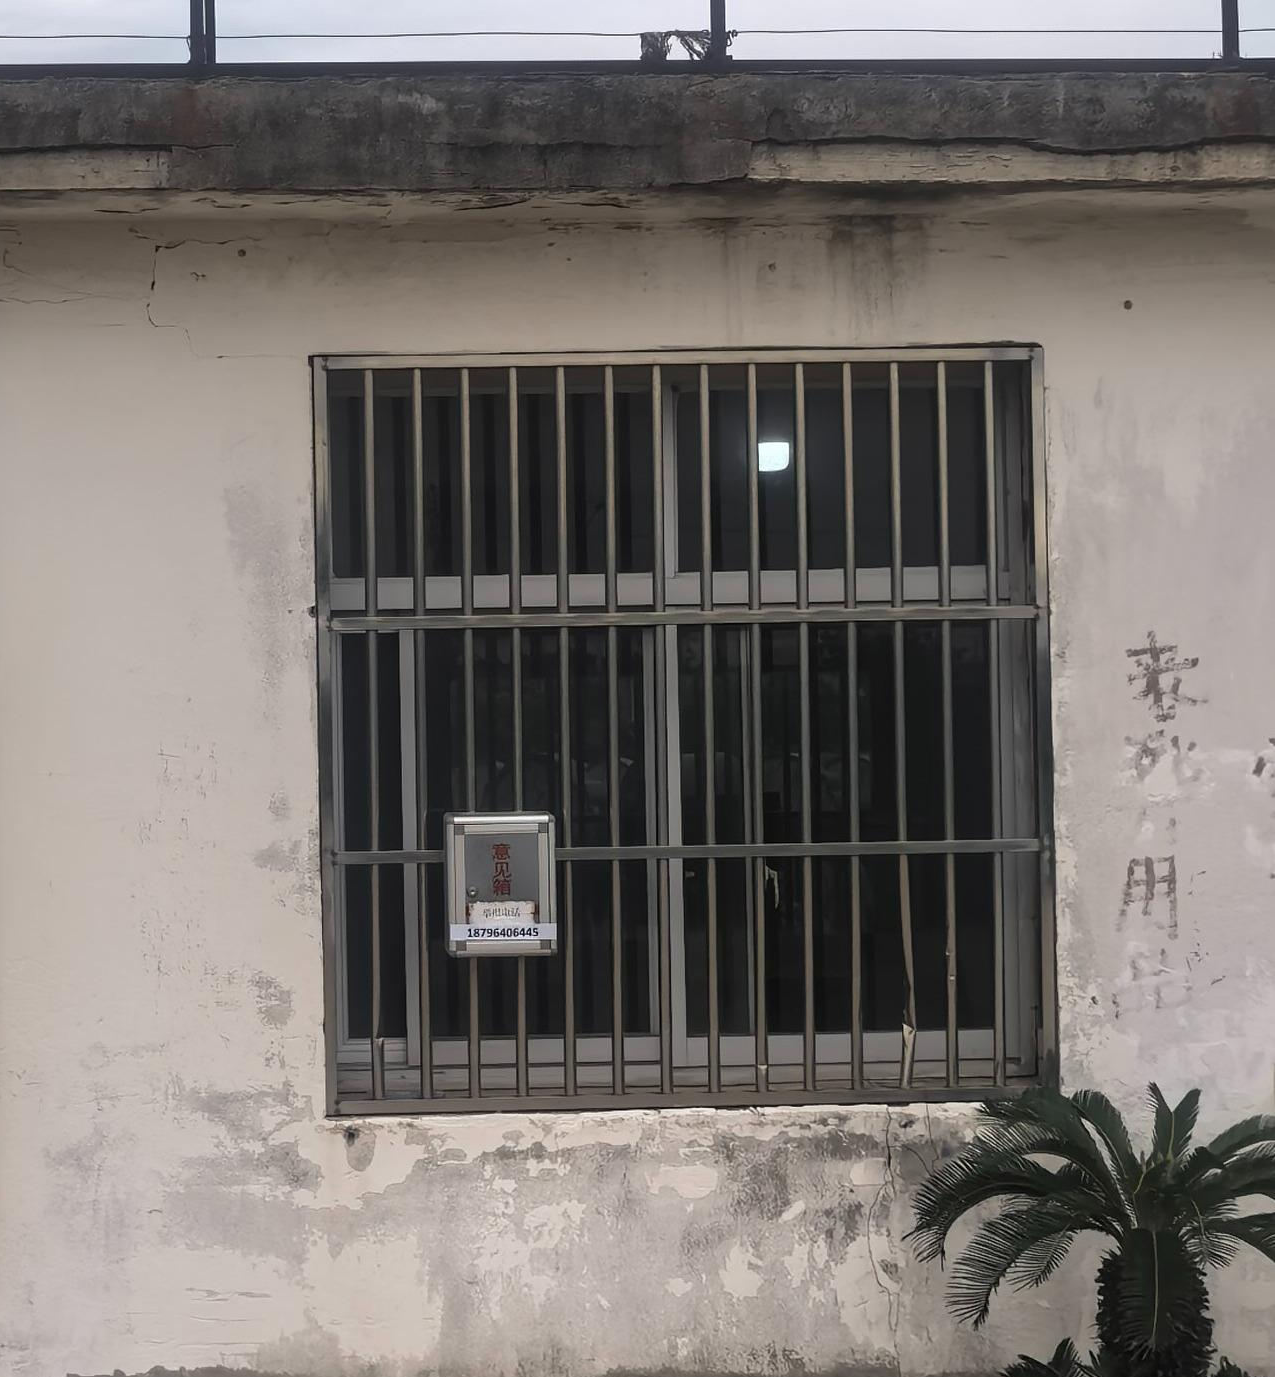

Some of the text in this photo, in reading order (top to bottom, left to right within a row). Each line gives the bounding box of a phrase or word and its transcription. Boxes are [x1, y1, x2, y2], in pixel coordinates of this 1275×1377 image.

[492, 843, 512, 896] 意见箱
[467, 928, 539, 938] 18796406445
